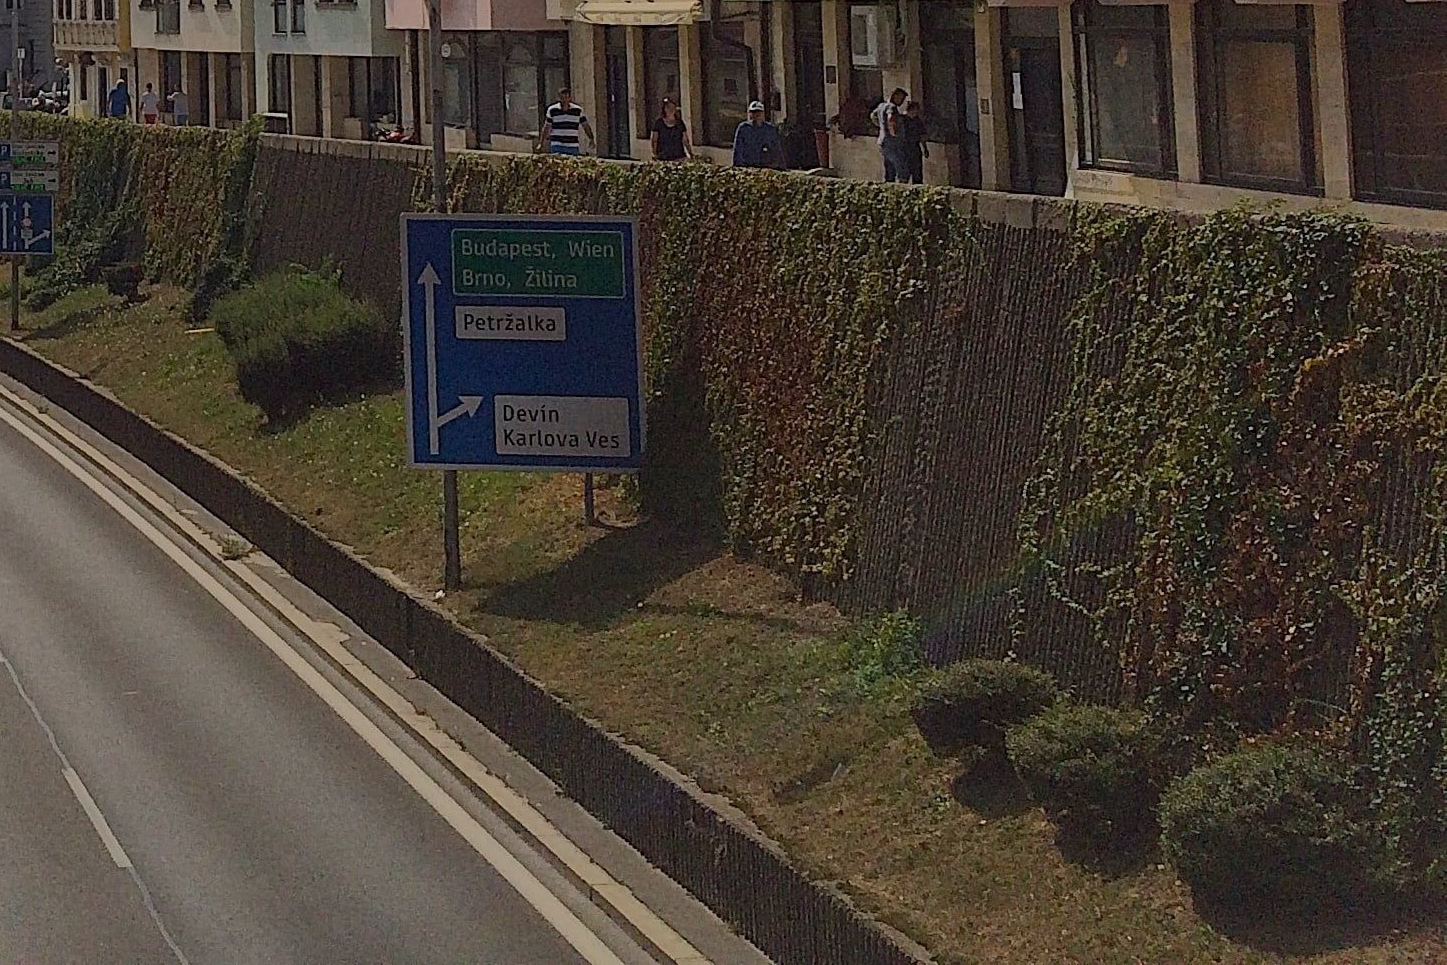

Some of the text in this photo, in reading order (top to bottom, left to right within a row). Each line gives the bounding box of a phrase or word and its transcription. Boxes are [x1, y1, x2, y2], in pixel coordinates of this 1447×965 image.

[461, 239, 614, 259] Budapest, Wien
[462, 267, 577, 288] Brno, Žilina
[463, 314, 556, 331] Petržalka
[503, 405, 559, 422] Devín
[503, 429, 620, 448] Karlova Ves
